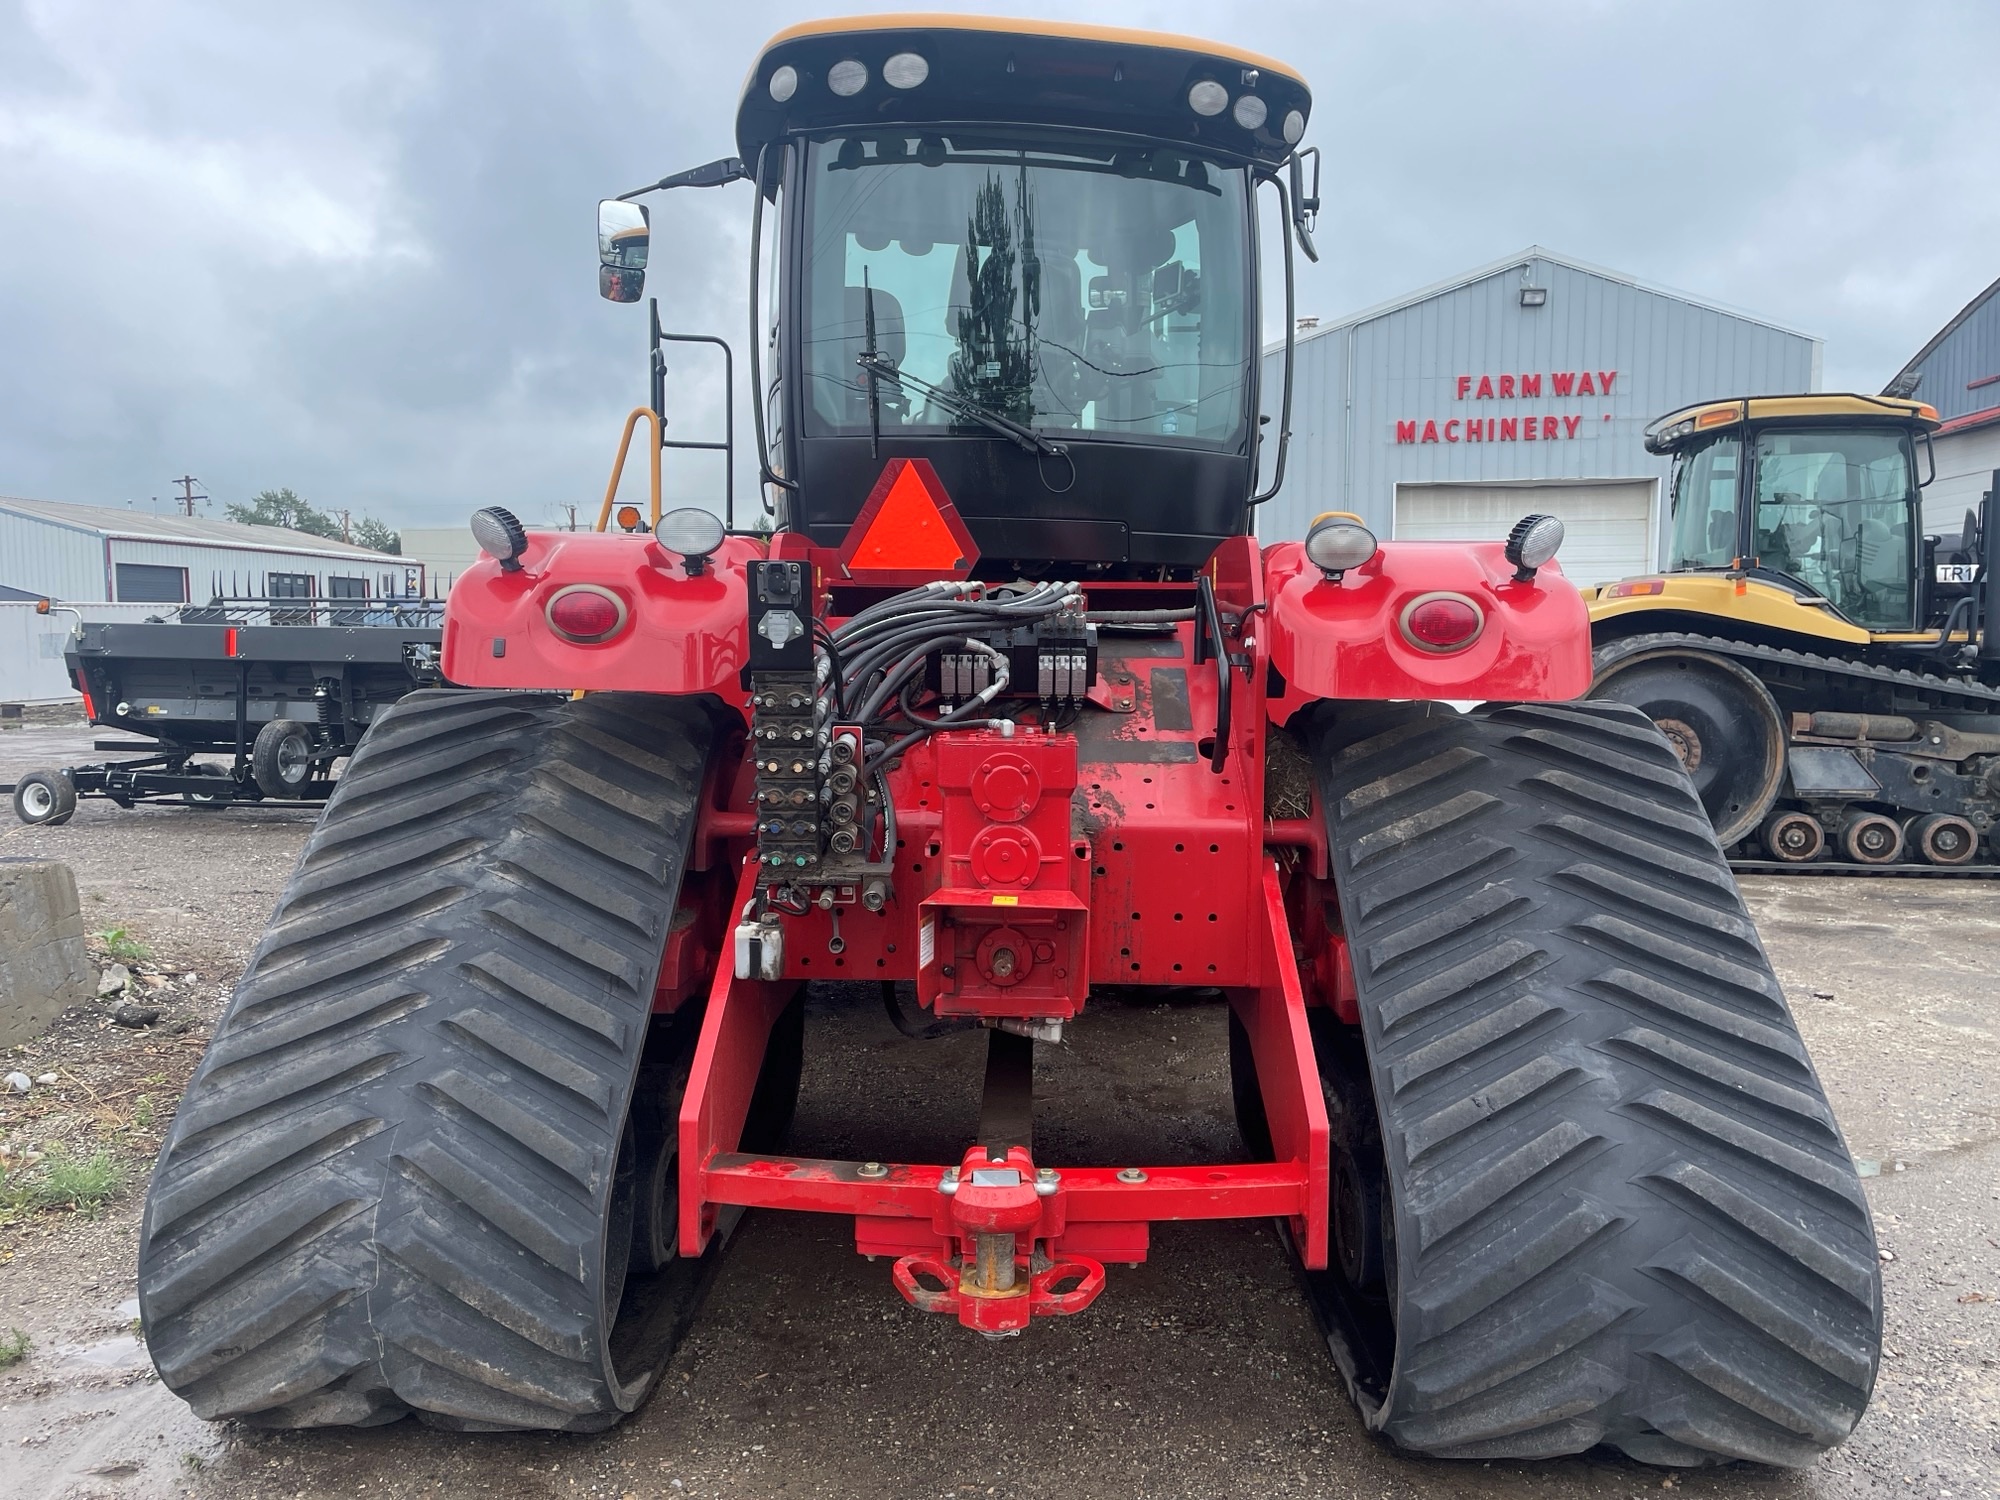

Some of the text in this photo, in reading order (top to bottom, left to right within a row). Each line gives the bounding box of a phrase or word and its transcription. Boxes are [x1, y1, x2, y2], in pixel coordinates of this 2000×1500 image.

[1457, 371, 1618, 399] FARM WAY
[1397, 415, 1581, 444] MACHINERY
[1940, 566, 1972, 582] TR1
